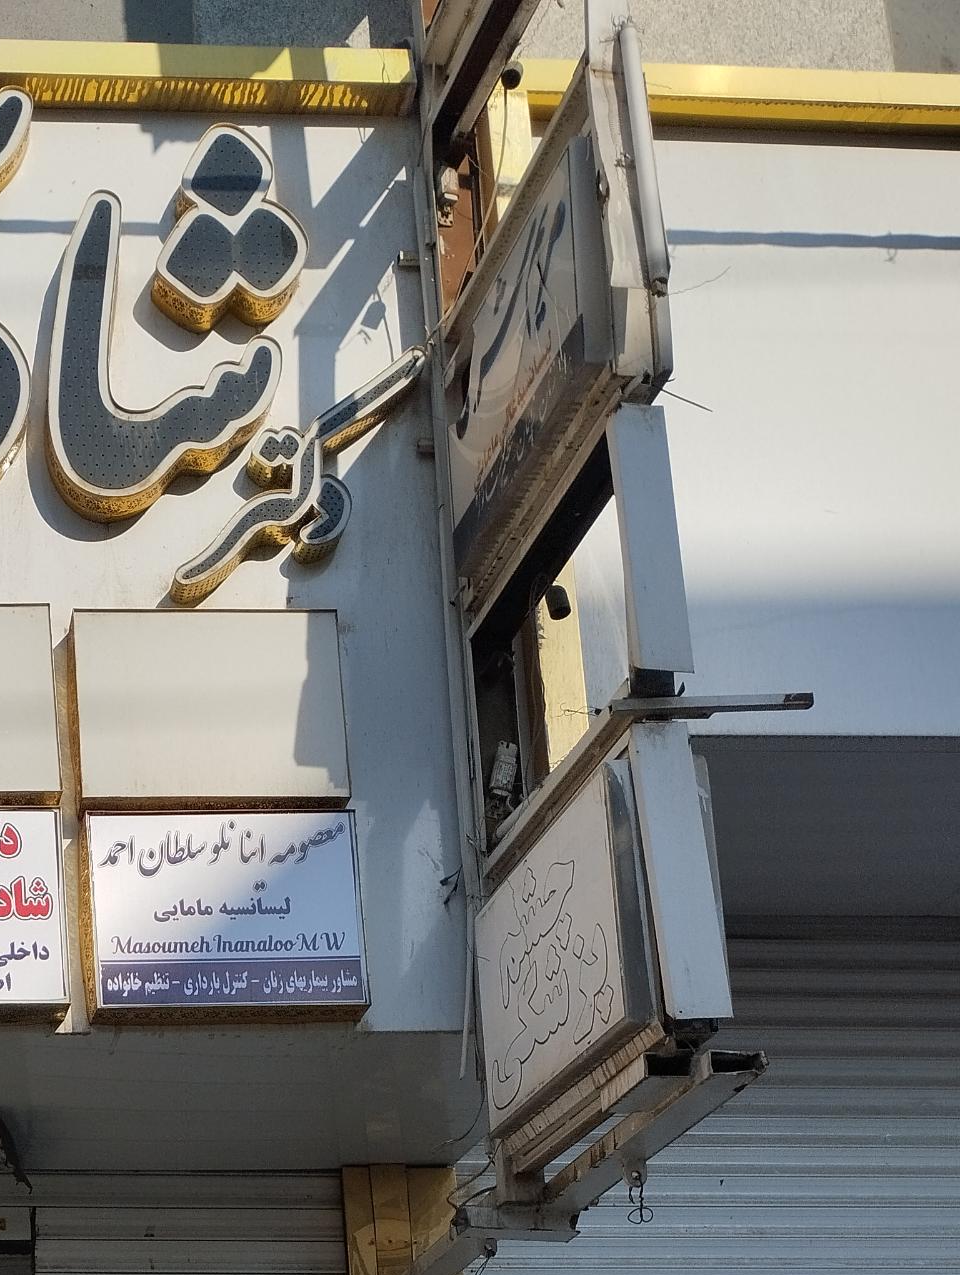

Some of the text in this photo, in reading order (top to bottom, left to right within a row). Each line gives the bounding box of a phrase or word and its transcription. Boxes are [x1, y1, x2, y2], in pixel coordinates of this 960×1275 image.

[168, 343, 428, 607] دکتر
[137, 831, 208, 879] سلطان
[268, 821, 346, 866] معصومه
[153, 896, 291, 923] لیسانسیه مامایی
[111, 934, 212, 956] Masoumeh
[213, 933, 296, 954] Inanaloo
[106, 971, 142, 998] خانواده
[144, 972, 171, 997] تنظیم
[183, 972, 221, 996] بارداری
[223, 971, 248, 995] کنترل
[263, 970, 284, 995] زنان
[331, 968, 358, 994] مشاور
